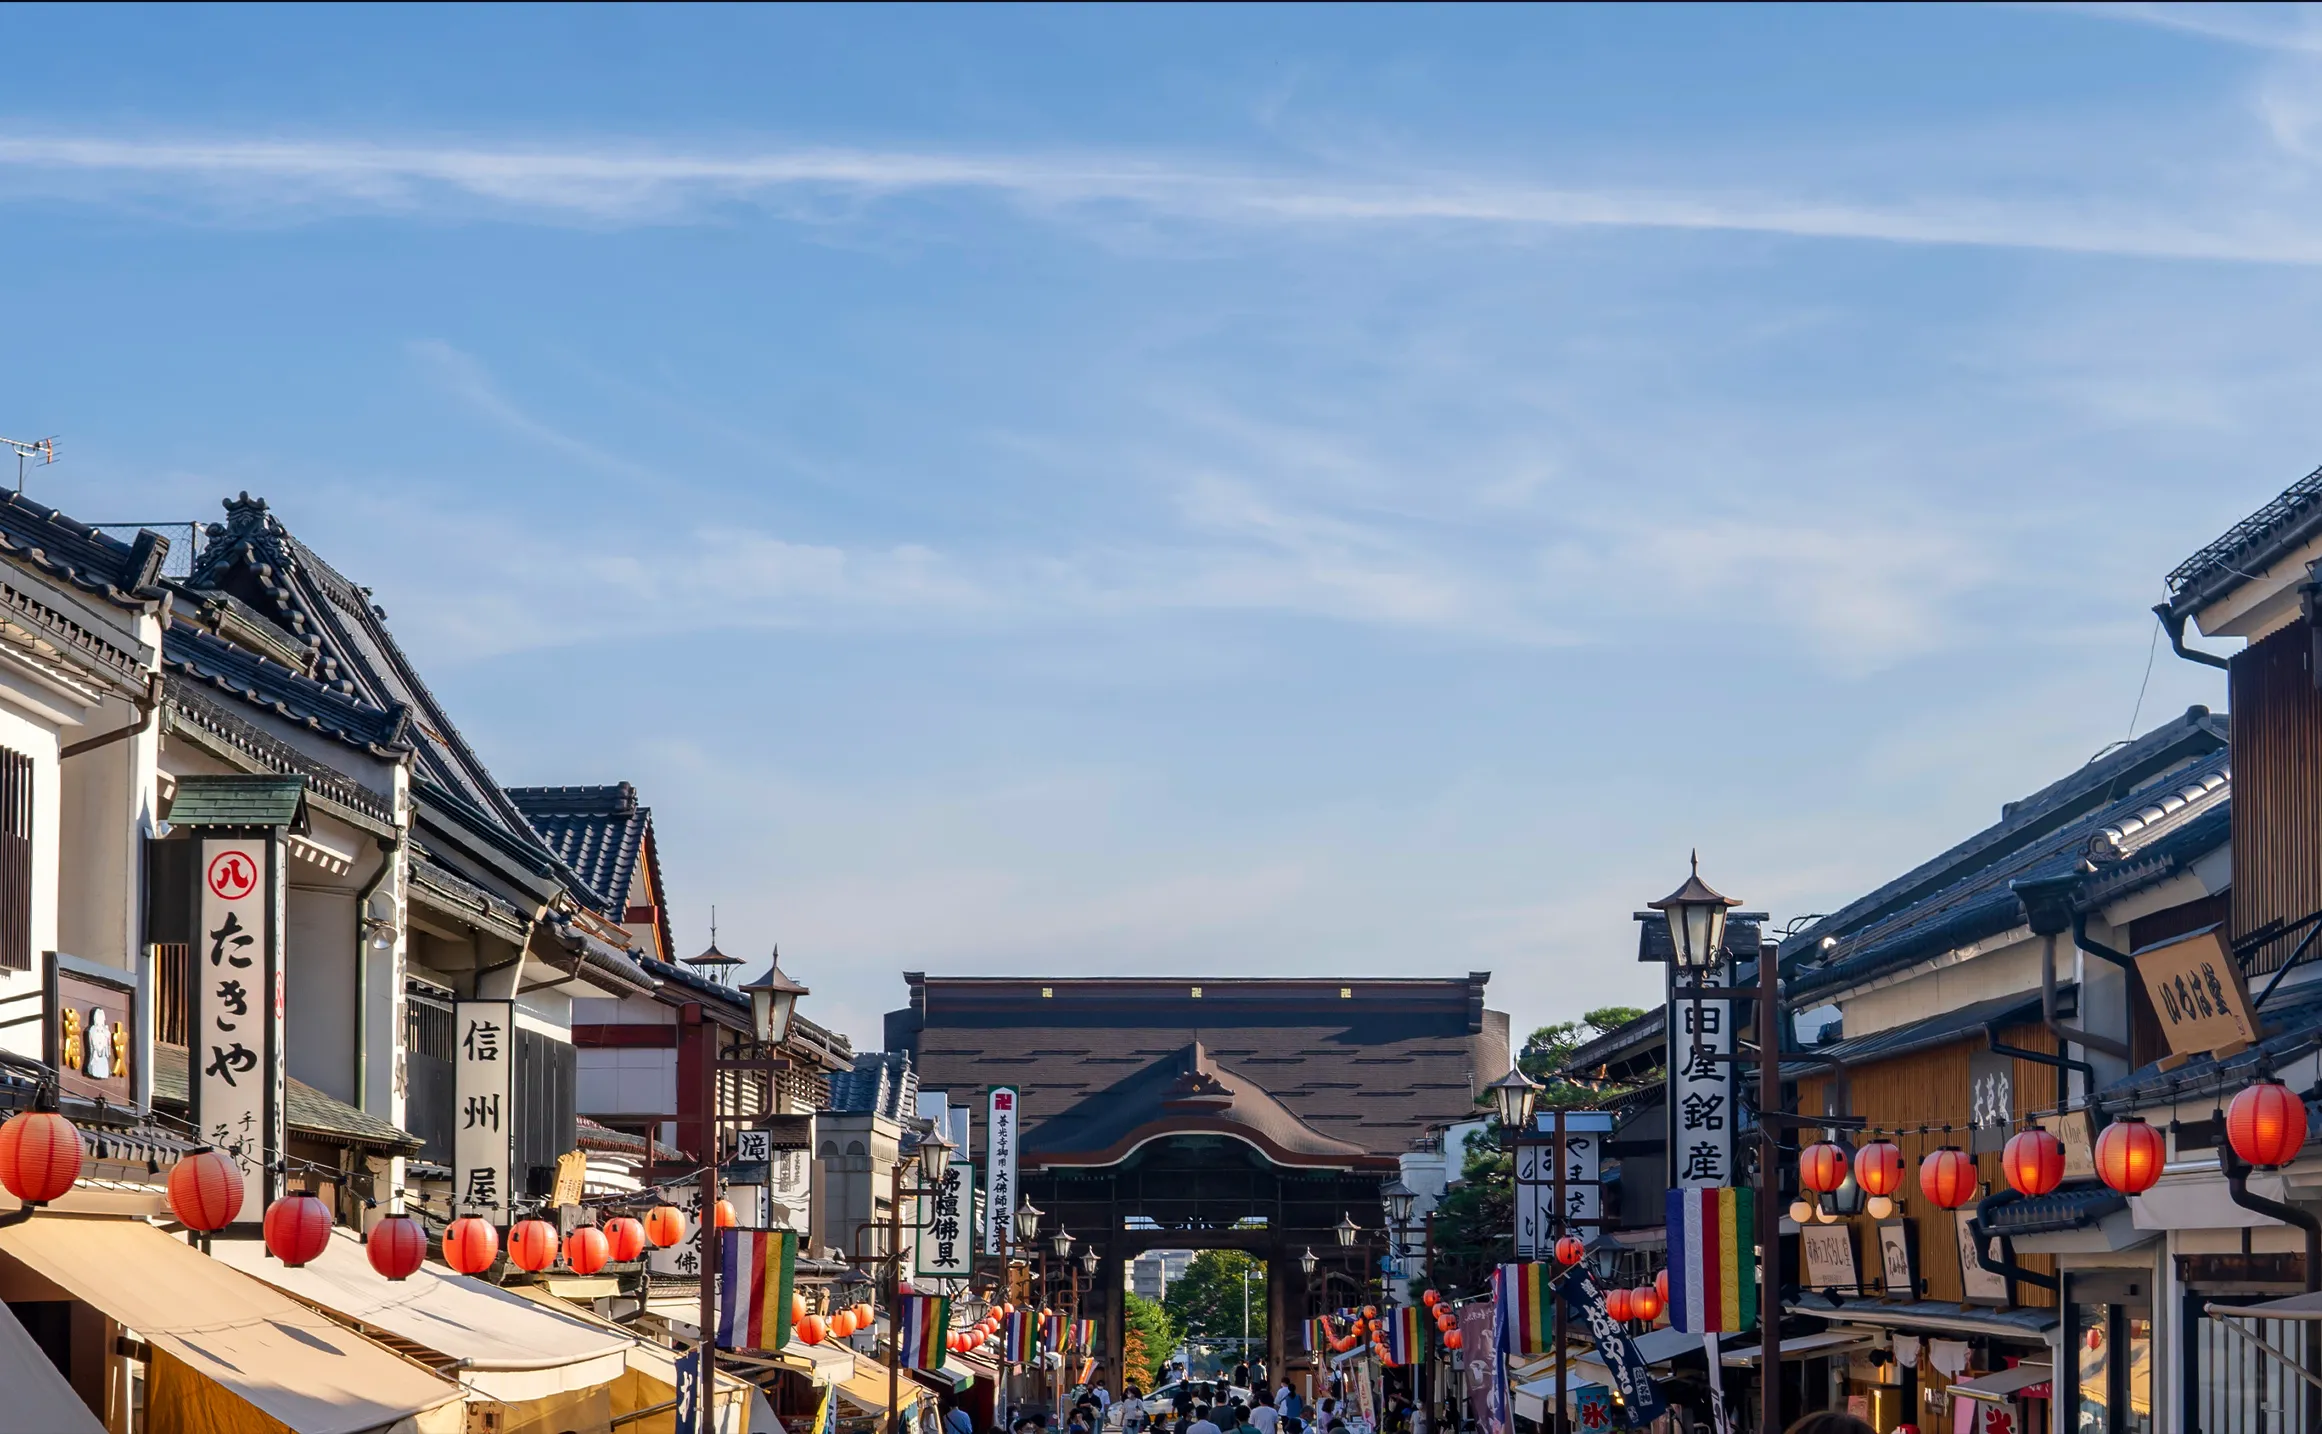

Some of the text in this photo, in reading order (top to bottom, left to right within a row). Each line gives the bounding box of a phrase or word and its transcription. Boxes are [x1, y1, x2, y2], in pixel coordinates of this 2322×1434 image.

[205, 911, 258, 1088] たきや
[235, 1110, 257, 1177] 手打ち
[463, 1019, 501, 1206] 信州屋
[1681, 979, 1726, 1181] 田屋銘産
[1582, 1304, 1634, 1395] おやき
[1582, 1401, 1609, 1429] 氷
